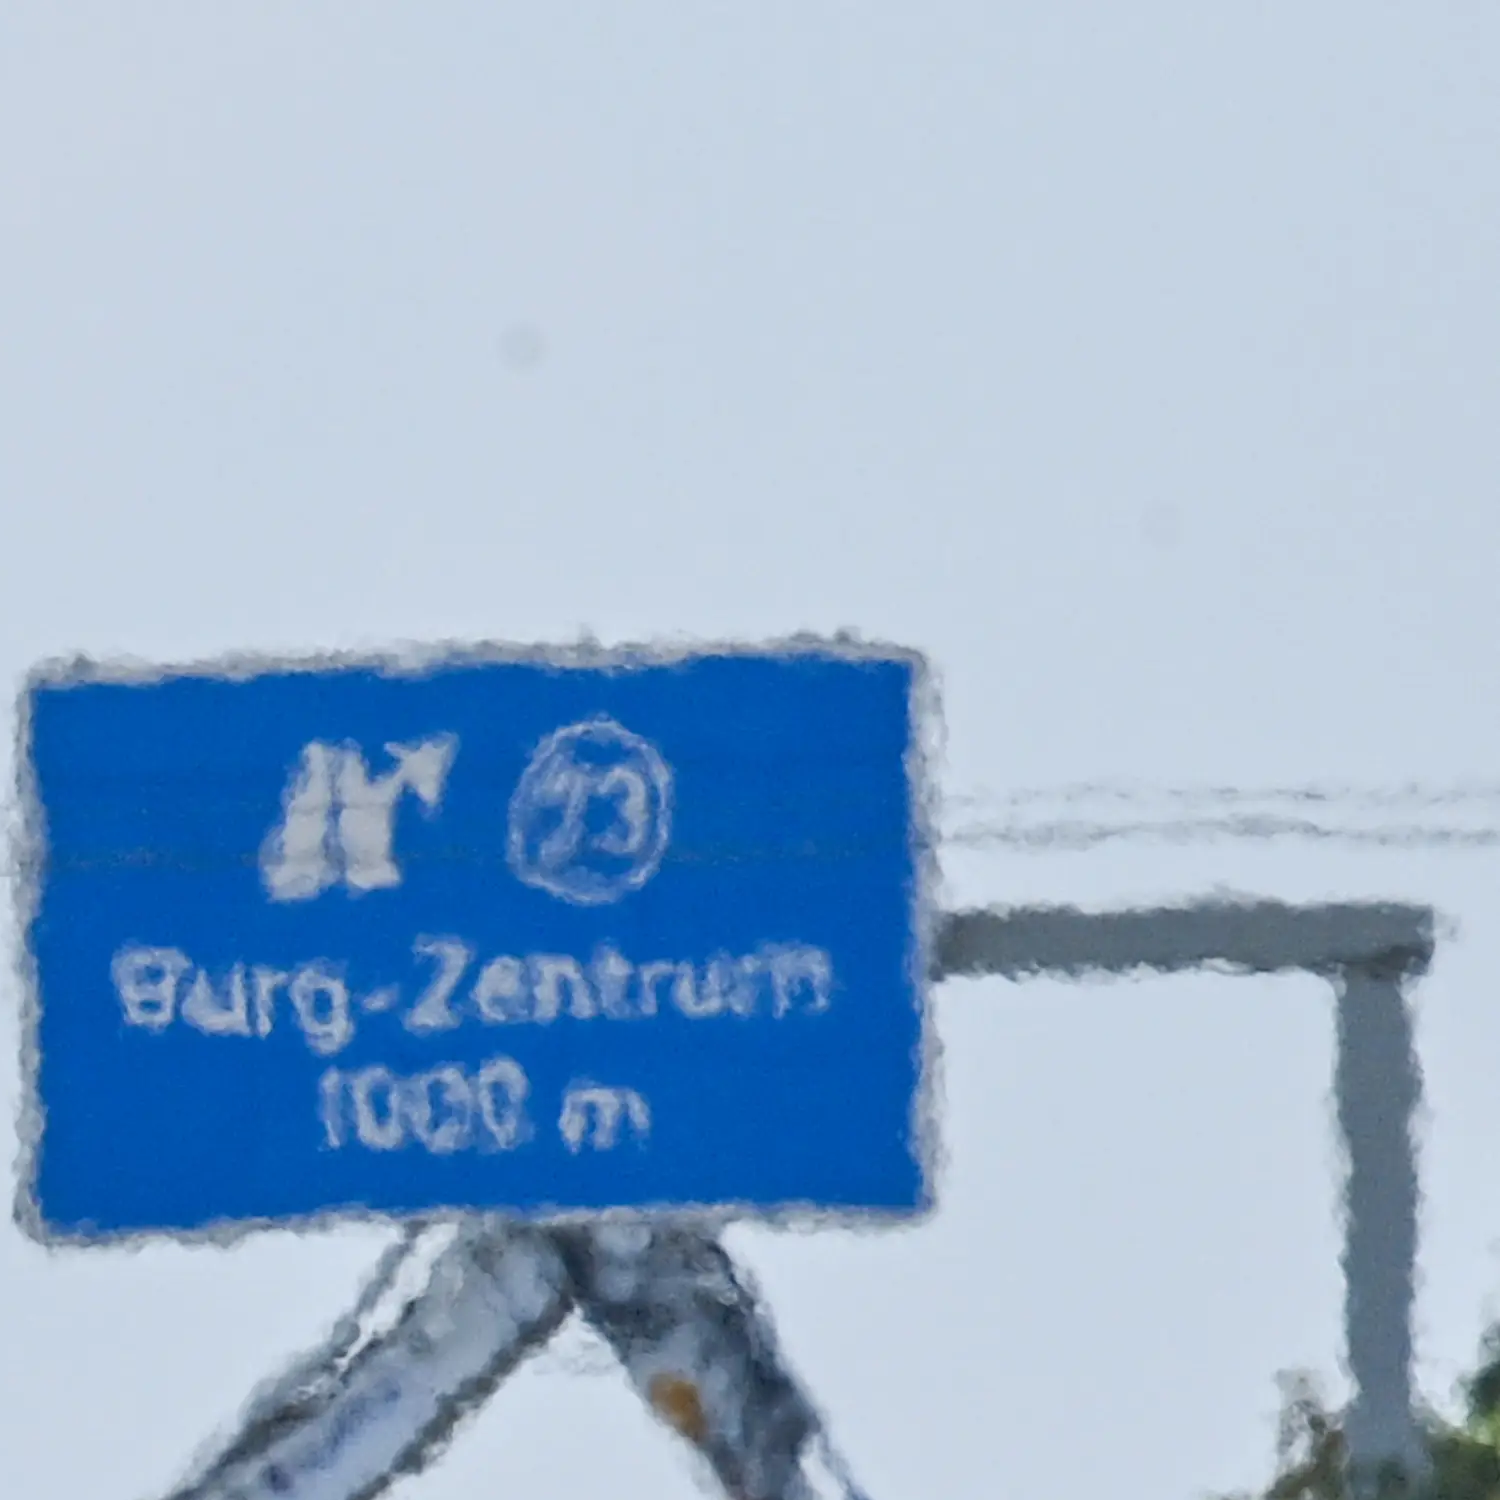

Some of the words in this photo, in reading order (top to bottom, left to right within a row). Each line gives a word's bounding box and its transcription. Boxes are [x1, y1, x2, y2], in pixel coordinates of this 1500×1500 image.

[112, 939, 832, 1054] Burg-Zentrum
[319, 1059, 531, 1152] 1000
[558, 1081, 649, 1151] m
